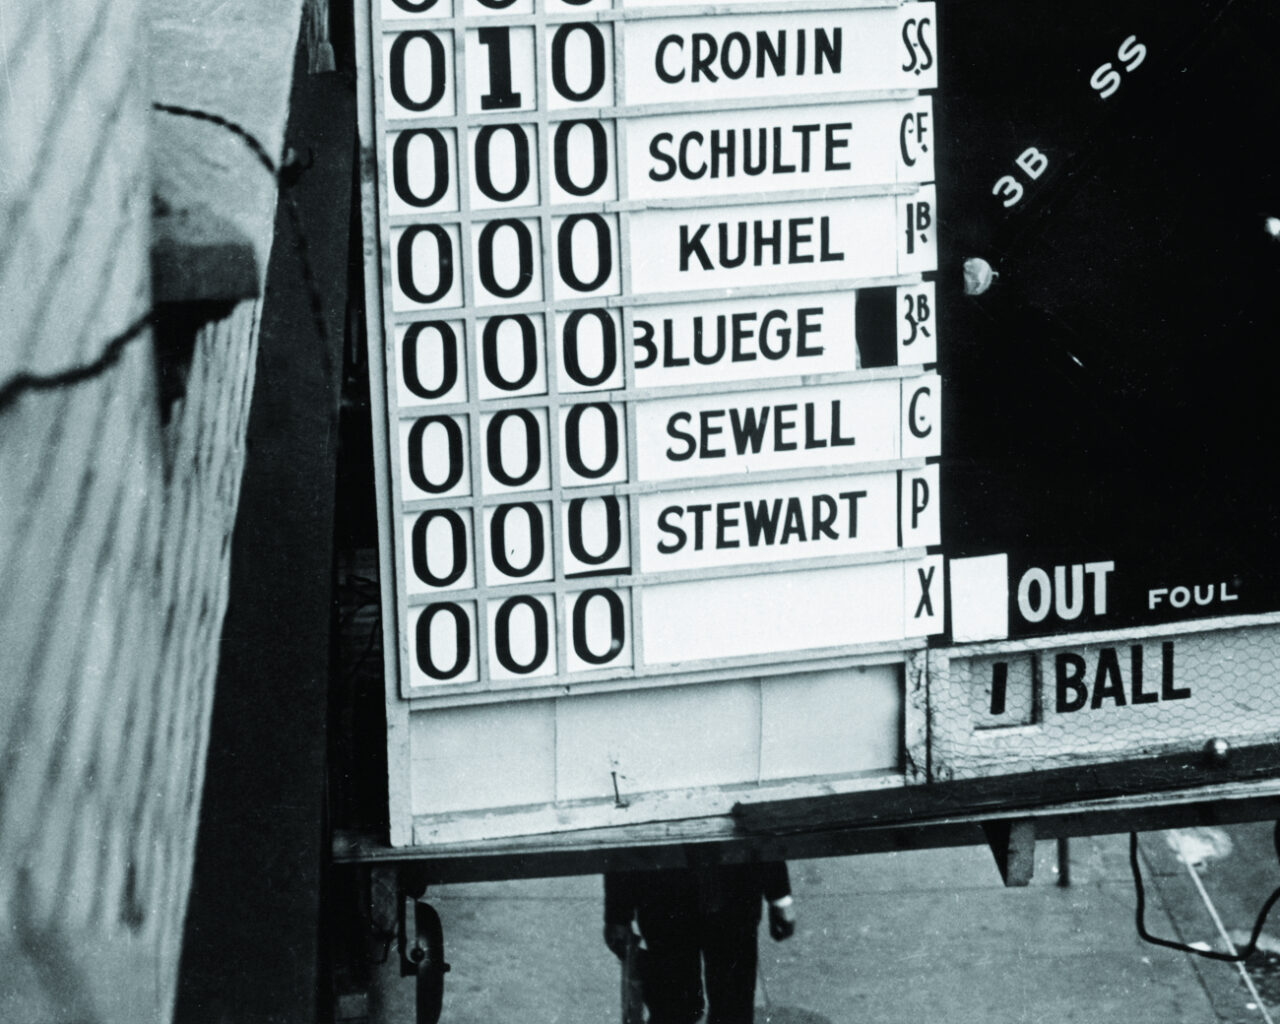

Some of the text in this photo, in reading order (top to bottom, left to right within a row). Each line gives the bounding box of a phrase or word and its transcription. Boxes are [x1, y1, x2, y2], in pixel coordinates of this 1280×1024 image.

[390, 30, 445, 111] 0
[478, 26, 521, 110] 1
[552, 22, 605, 101] 0
[655, 28, 842, 83] CRONIN
[1090, 36, 1146, 98] SS
[393, 128, 449, 207] 0
[475, 123, 529, 201] 0
[554, 118, 607, 196] 0
[649, 123, 852, 181] SCHULTE
[993, 147, 1048, 207] 3B
[398, 224, 453, 303] 0
[479, 218, 533, 298] 0
[558, 213, 611, 292] 0
[680, 216, 844, 271] KUHEL
[403, 320, 457, 399] 0
[483, 314, 537, 391] 0
[563, 308, 616, 386] 0
[408, 387, 932, 493] 0 0 0 SEWELL C
[412, 477, 930, 587] 0 0 0 STEWART P
[416, 565, 936, 680] 0 0 0 X
[1018, 561, 1114, 622] OUT
[1149, 583, 1238, 609] FOUL
[990, 640, 1191, 714] 1 BALL
